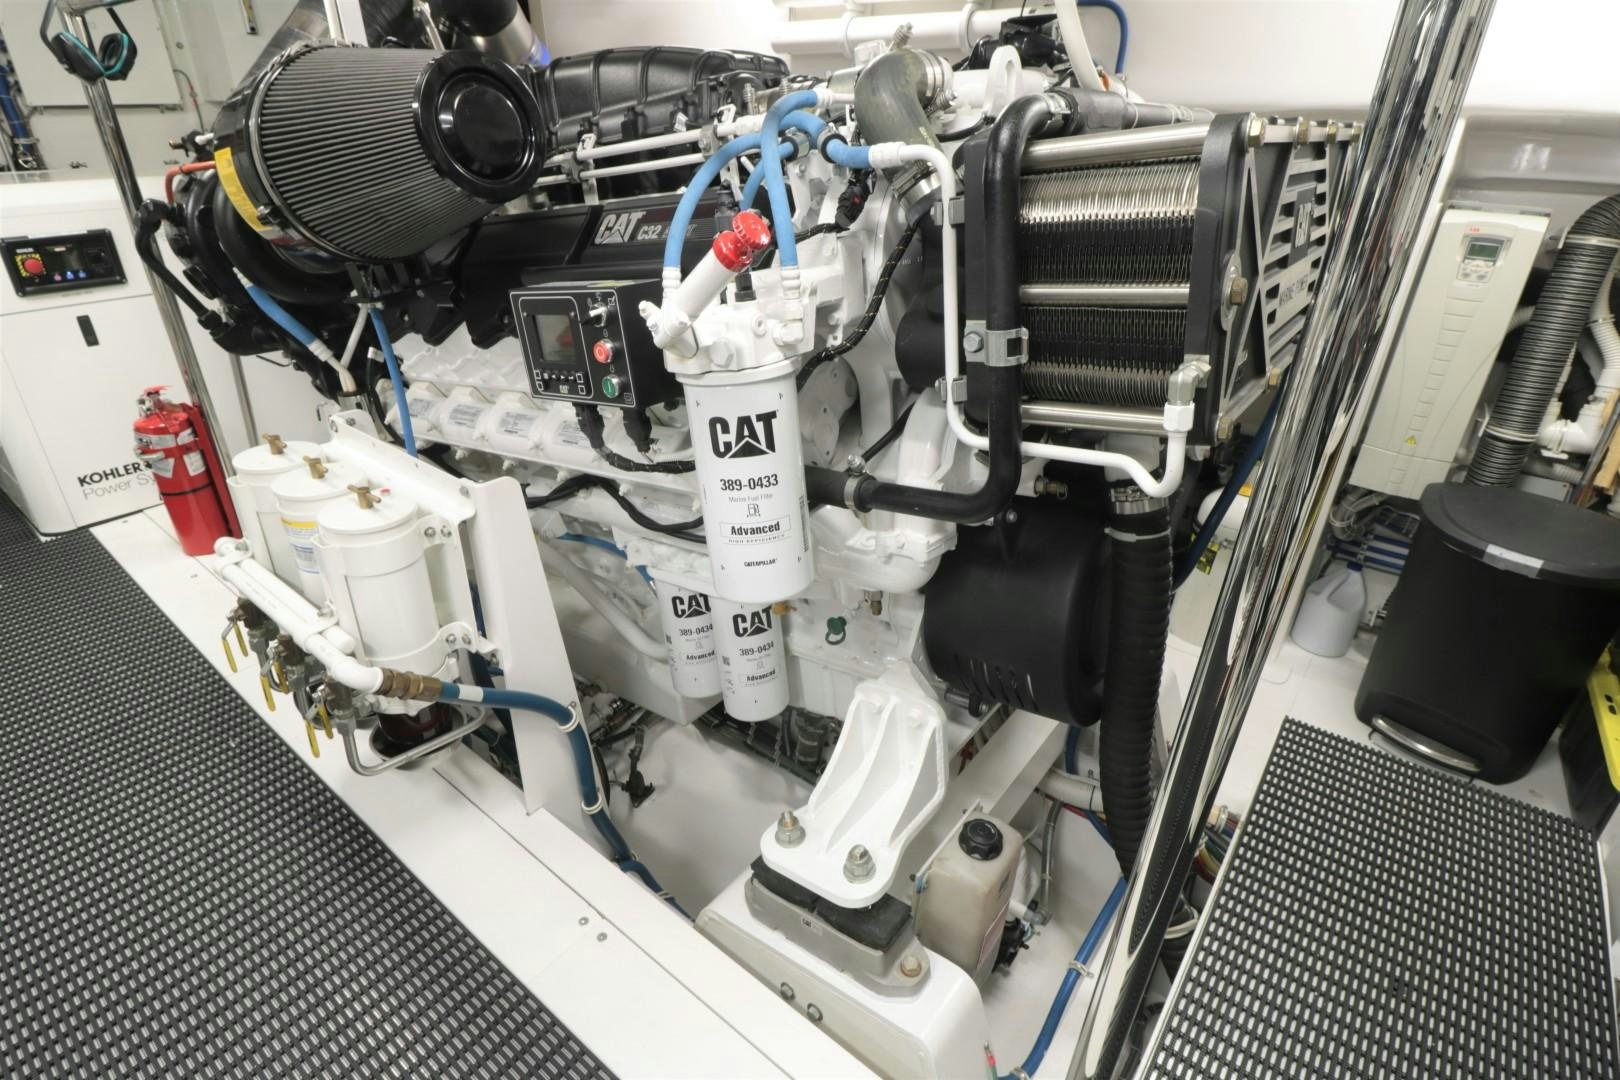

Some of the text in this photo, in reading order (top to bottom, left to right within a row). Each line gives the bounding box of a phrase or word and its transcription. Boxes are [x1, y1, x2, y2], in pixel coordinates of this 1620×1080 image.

[594, 210, 647, 245] CAT
[637, 224, 663, 240] C32
[708, 410, 778, 459] CAT
[77, 461, 143, 488] KOHLER
[719, 473, 779, 492] 389-0433
[82, 479, 131, 500] Power
[730, 520, 781, 536] Advanced
[671, 593, 711, 619] CAT
[732, 605, 773, 638] CAT
[686, 650, 715, 661] Advanced
[739, 640, 774, 656] 389-0434
[746, 668, 776, 682] Advanced
